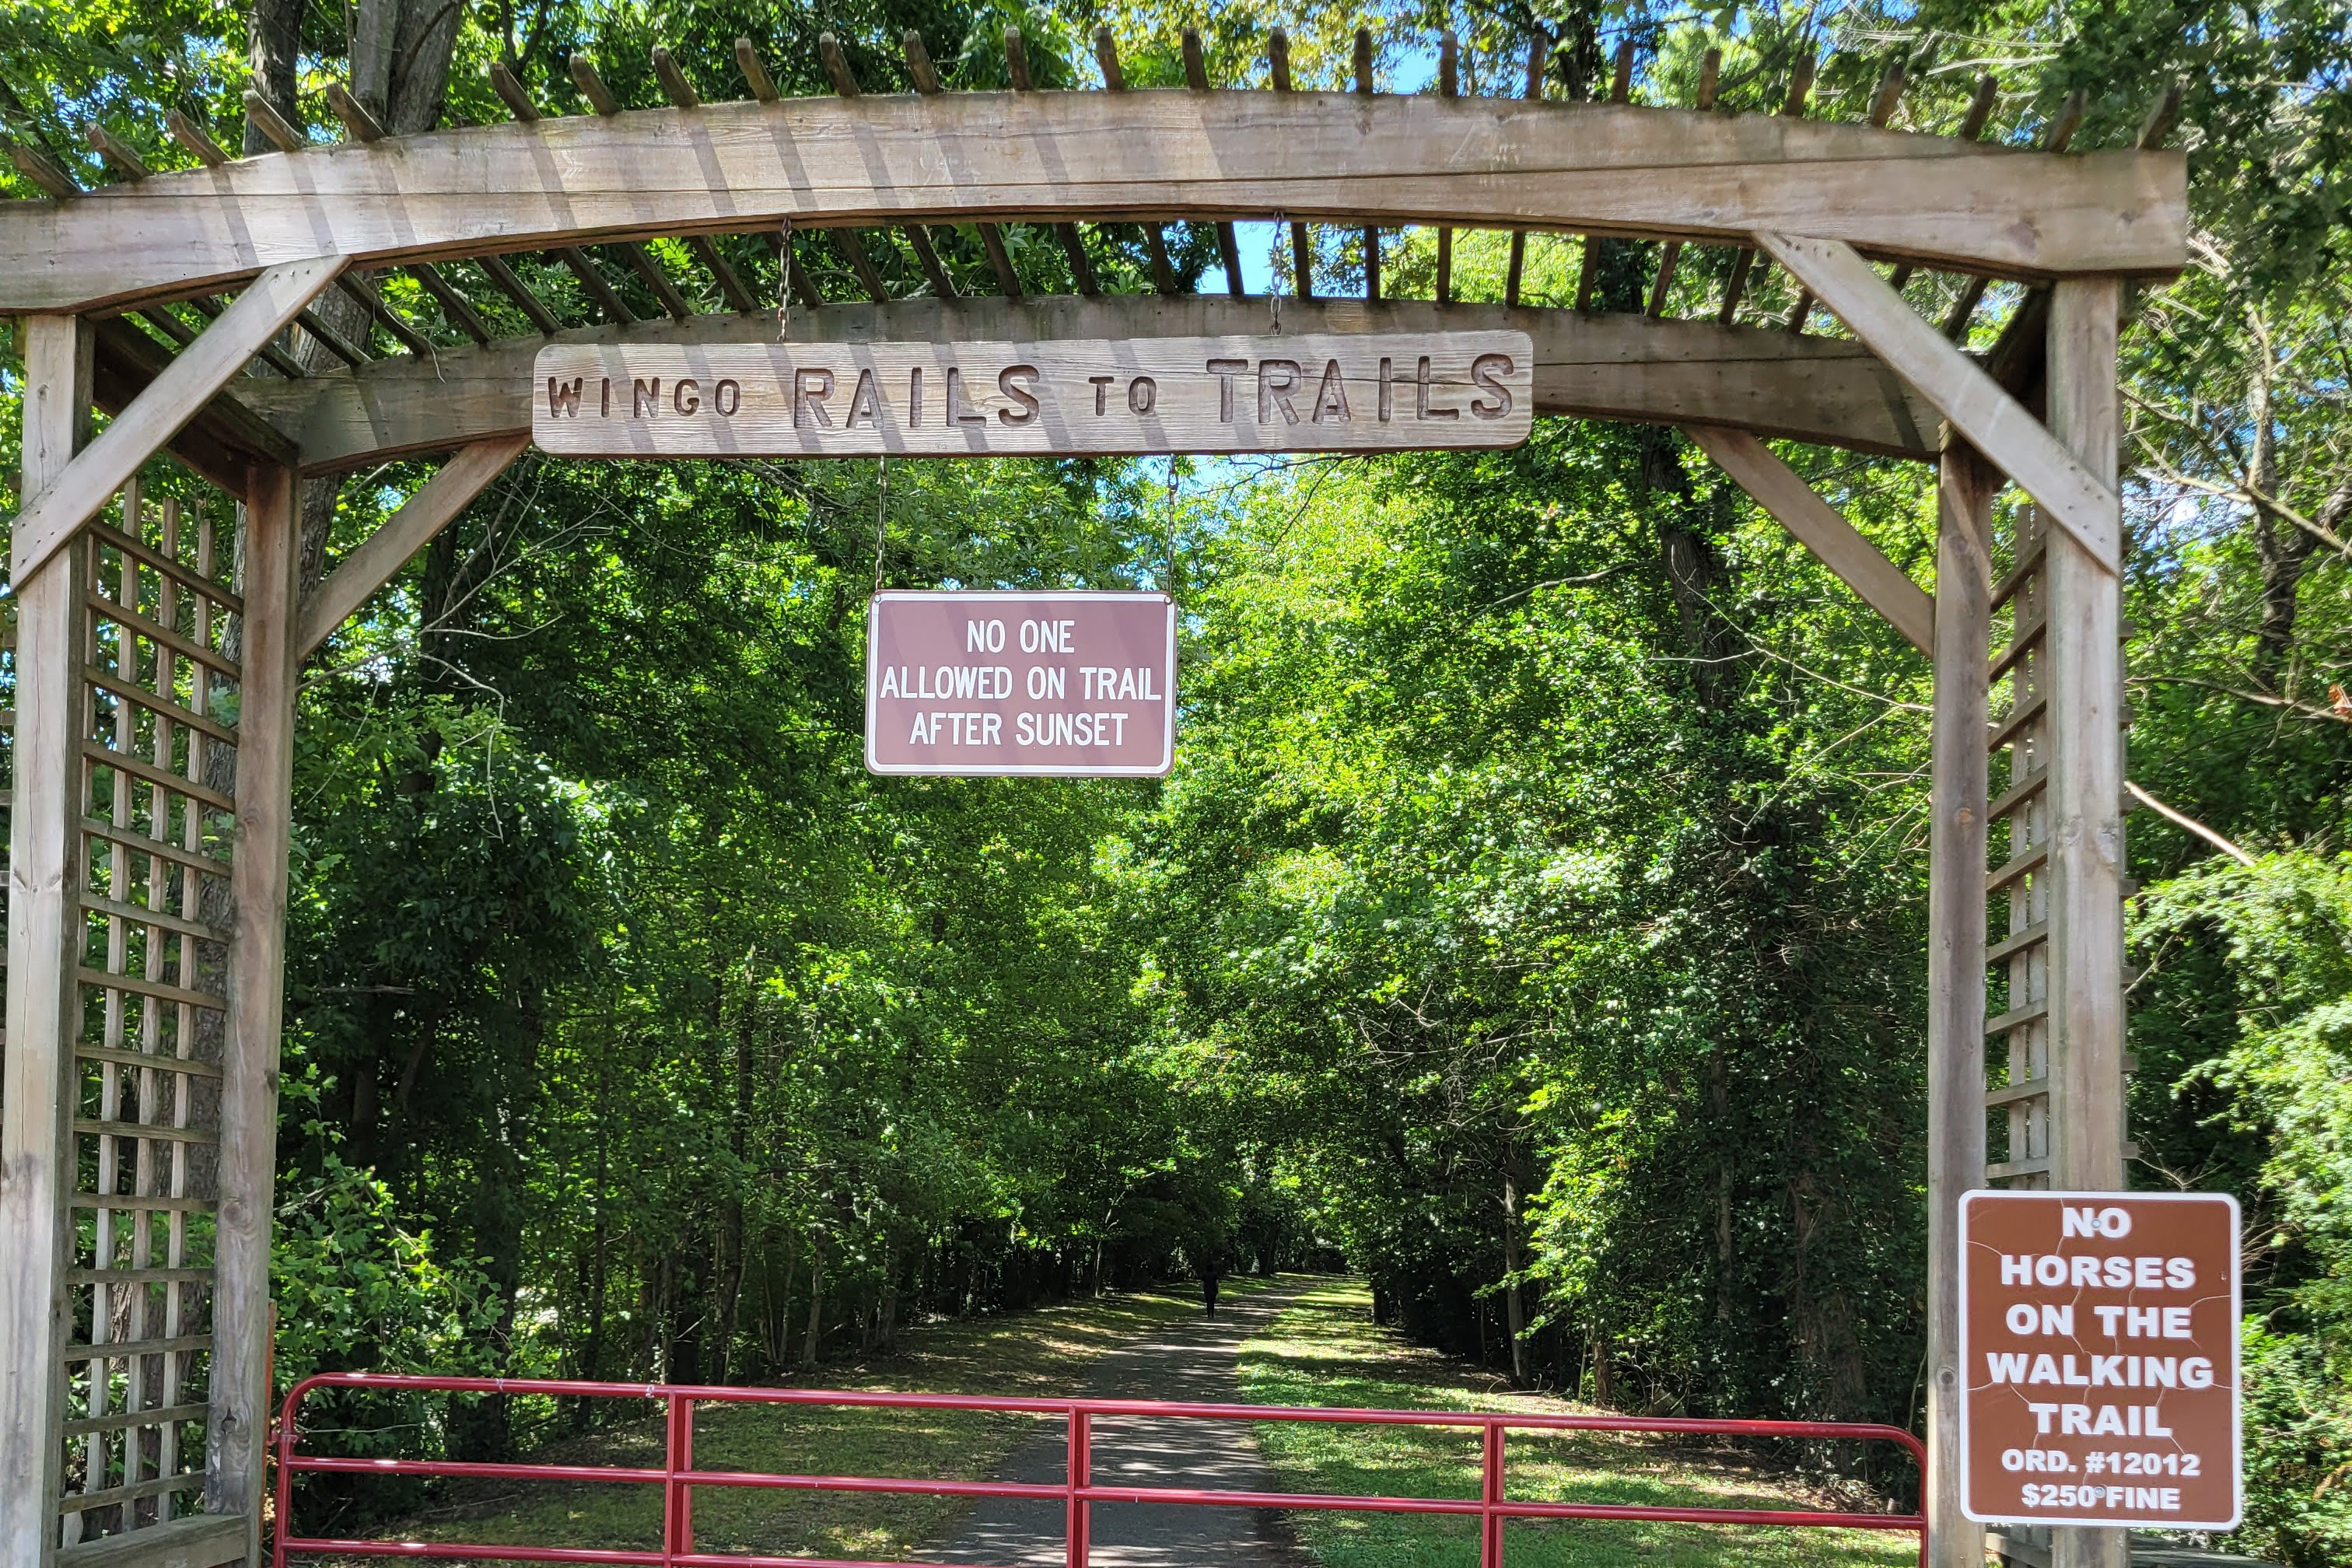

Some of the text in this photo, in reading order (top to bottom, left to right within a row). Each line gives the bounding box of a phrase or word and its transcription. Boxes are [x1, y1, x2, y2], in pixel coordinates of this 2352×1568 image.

[548, 353, 1514, 429] WINGO RAILS TO TRAILS
[967, 620, 1075, 653] NO ONE
[880, 666, 1161, 700] ALLOWED ON TRAIL
[908, 712, 1129, 746] AFTER SUNSET
[2063, 1207, 2133, 1238] NO
[2000, 1255, 2196, 1289] HORSES
[2006, 1304, 2193, 1338] ON THE
[1986, 1352, 2214, 1388] WALKING
[2028, 1402, 2173, 1437] TRAIL
[2001, 1448, 2201, 1476] ORD. #12012
[2021, 1483, 2182, 1510] $250 FINE
